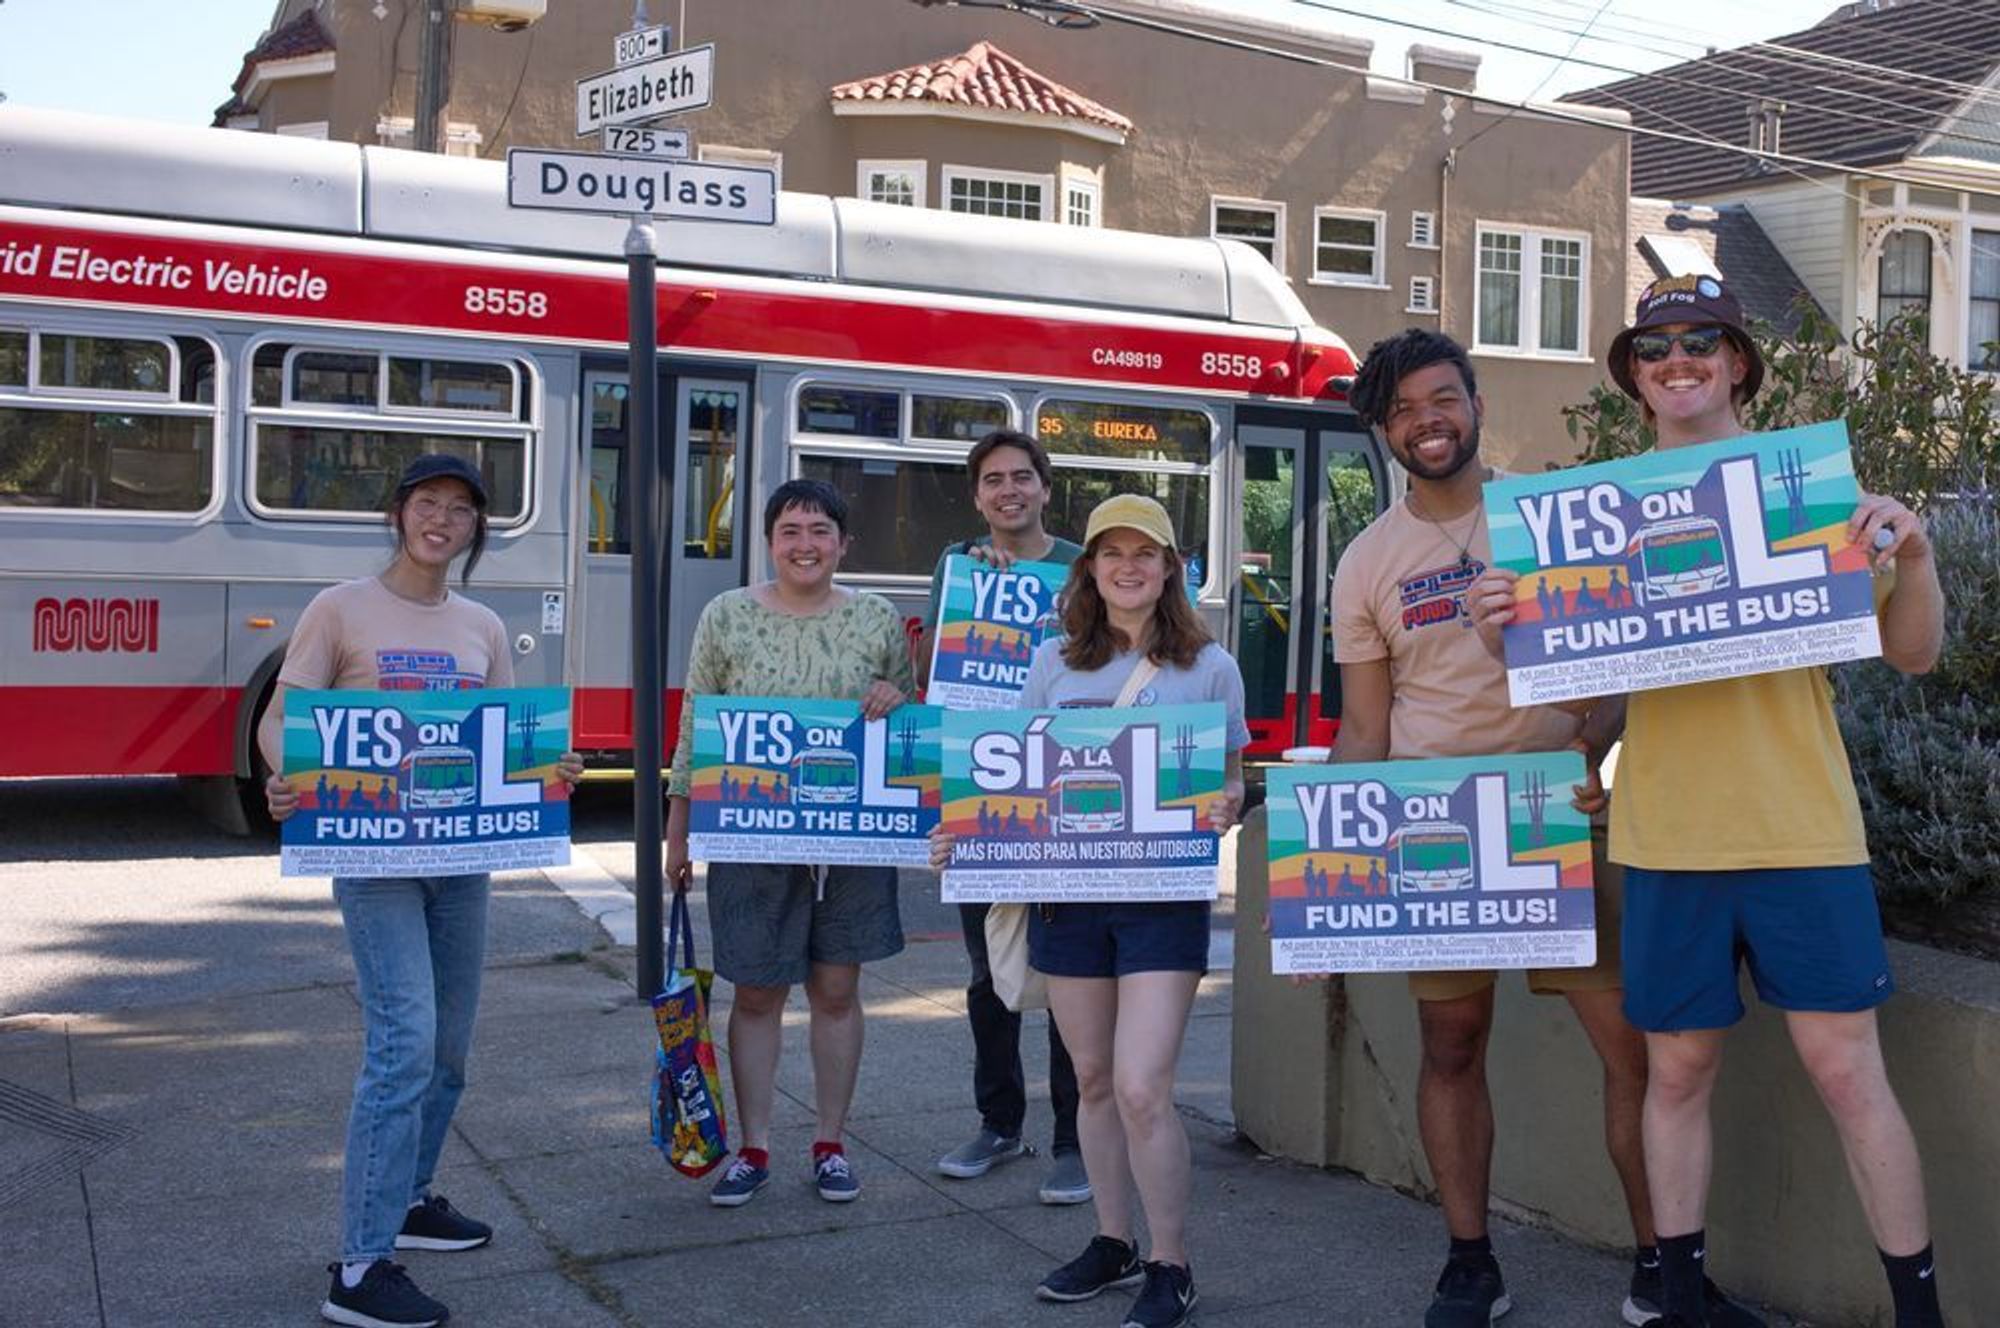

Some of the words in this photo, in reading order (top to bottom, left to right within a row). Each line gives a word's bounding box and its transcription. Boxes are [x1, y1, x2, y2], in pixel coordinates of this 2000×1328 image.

[620, 34, 645, 61] 800
[590, 66, 694, 120] Elizabeth
[609, 129, 656, 152] 725
[541, 162, 747, 210] Douglass
[50, 246, 192, 290] Electric
[204, 260, 328, 301] Vehicle
[464, 286, 548, 318] 8558
[1092, 348, 1162, 369] CA49819
[1202, 352, 1262, 379] 8558
[1040, 417, 1063, 434] 35
[1094, 420, 1158, 441] EUREKA
[1520, 484, 1627, 566] YES
[1642, 488, 1694, 520] ON
[1721, 459, 1827, 589] L
[973, 572, 1040, 624] YES
[1543, 616, 1647, 655] FUND
[1653, 605, 1730, 637] THE
[1738, 586, 1830, 627] BUS!
[962, 661, 1030, 685] FUND
[314, 708, 401, 767] YES
[418, 723, 459, 744] ON
[481, 706, 541, 807] L
[720, 711, 793, 765] YES
[807, 728, 843, 747] ON
[863, 718, 919, 807] L
[972, 717, 1051, 790] SÍ
[1058, 750, 1075, 767] A
[1084, 749, 1112, 766] LA
[1132, 727, 1194, 833] L
[317, 816, 405, 839] FUND
[414, 815, 471, 837] THE
[477, 810, 539, 834] BUS!
[719, 808, 796, 829] FUND
[802, 810, 853, 831] THE
[859, 812, 917, 833] BUS!
[1296, 783, 1389, 848] YES
[1404, 796, 1449, 820] ON
[1476, 776, 1557, 891] L
[988, 842, 1042, 861] FONDOS
[1044, 842, 1076, 860] PARA
[1080, 840, 1143, 860] NUESTROS
[1145, 838, 1213, 858] AUTOBUSES!
[1306, 904, 1398, 930] FUND
[1405, 901, 1470, 926] THE
[1478, 898, 1556, 925] BUS!
